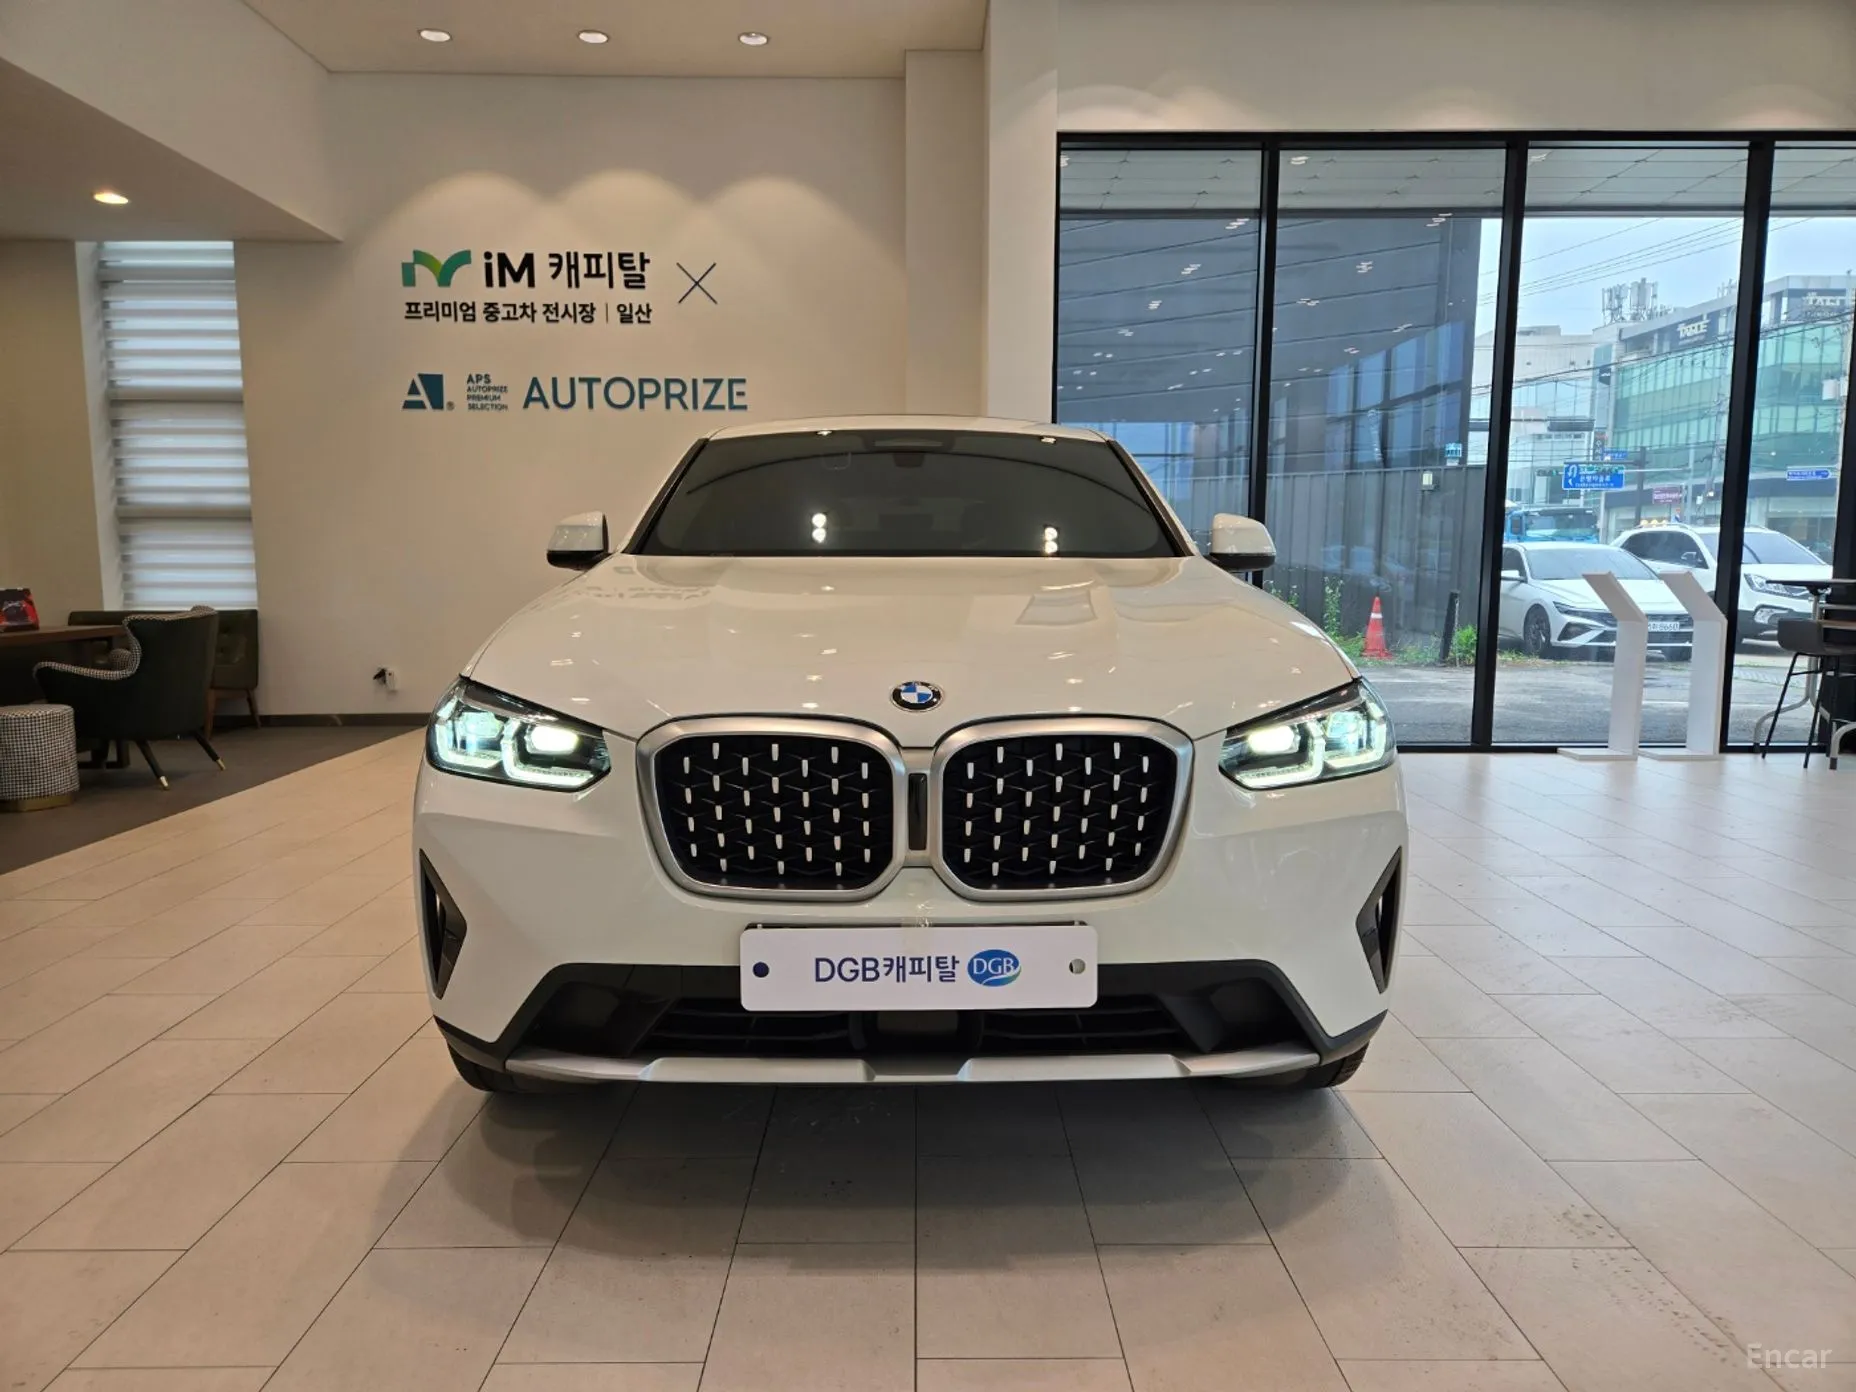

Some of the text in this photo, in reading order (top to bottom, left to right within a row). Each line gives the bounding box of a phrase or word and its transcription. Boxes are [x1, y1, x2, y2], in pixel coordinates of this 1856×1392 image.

[483, 250, 651, 290] iM 캐피탈
[404, 300, 653, 325] 프리미엄 중고차 전시장 일산
[466, 373, 492, 385] APS
[466, 385, 509, 394] AUTOPRIZE
[466, 394, 501, 402] PREMIUM
[522, 376, 748, 411] AUTOPRIZE
[467, 403, 509, 412] SELECTION
[814, 955, 1015, 983] DGB캐피탈 DGB
